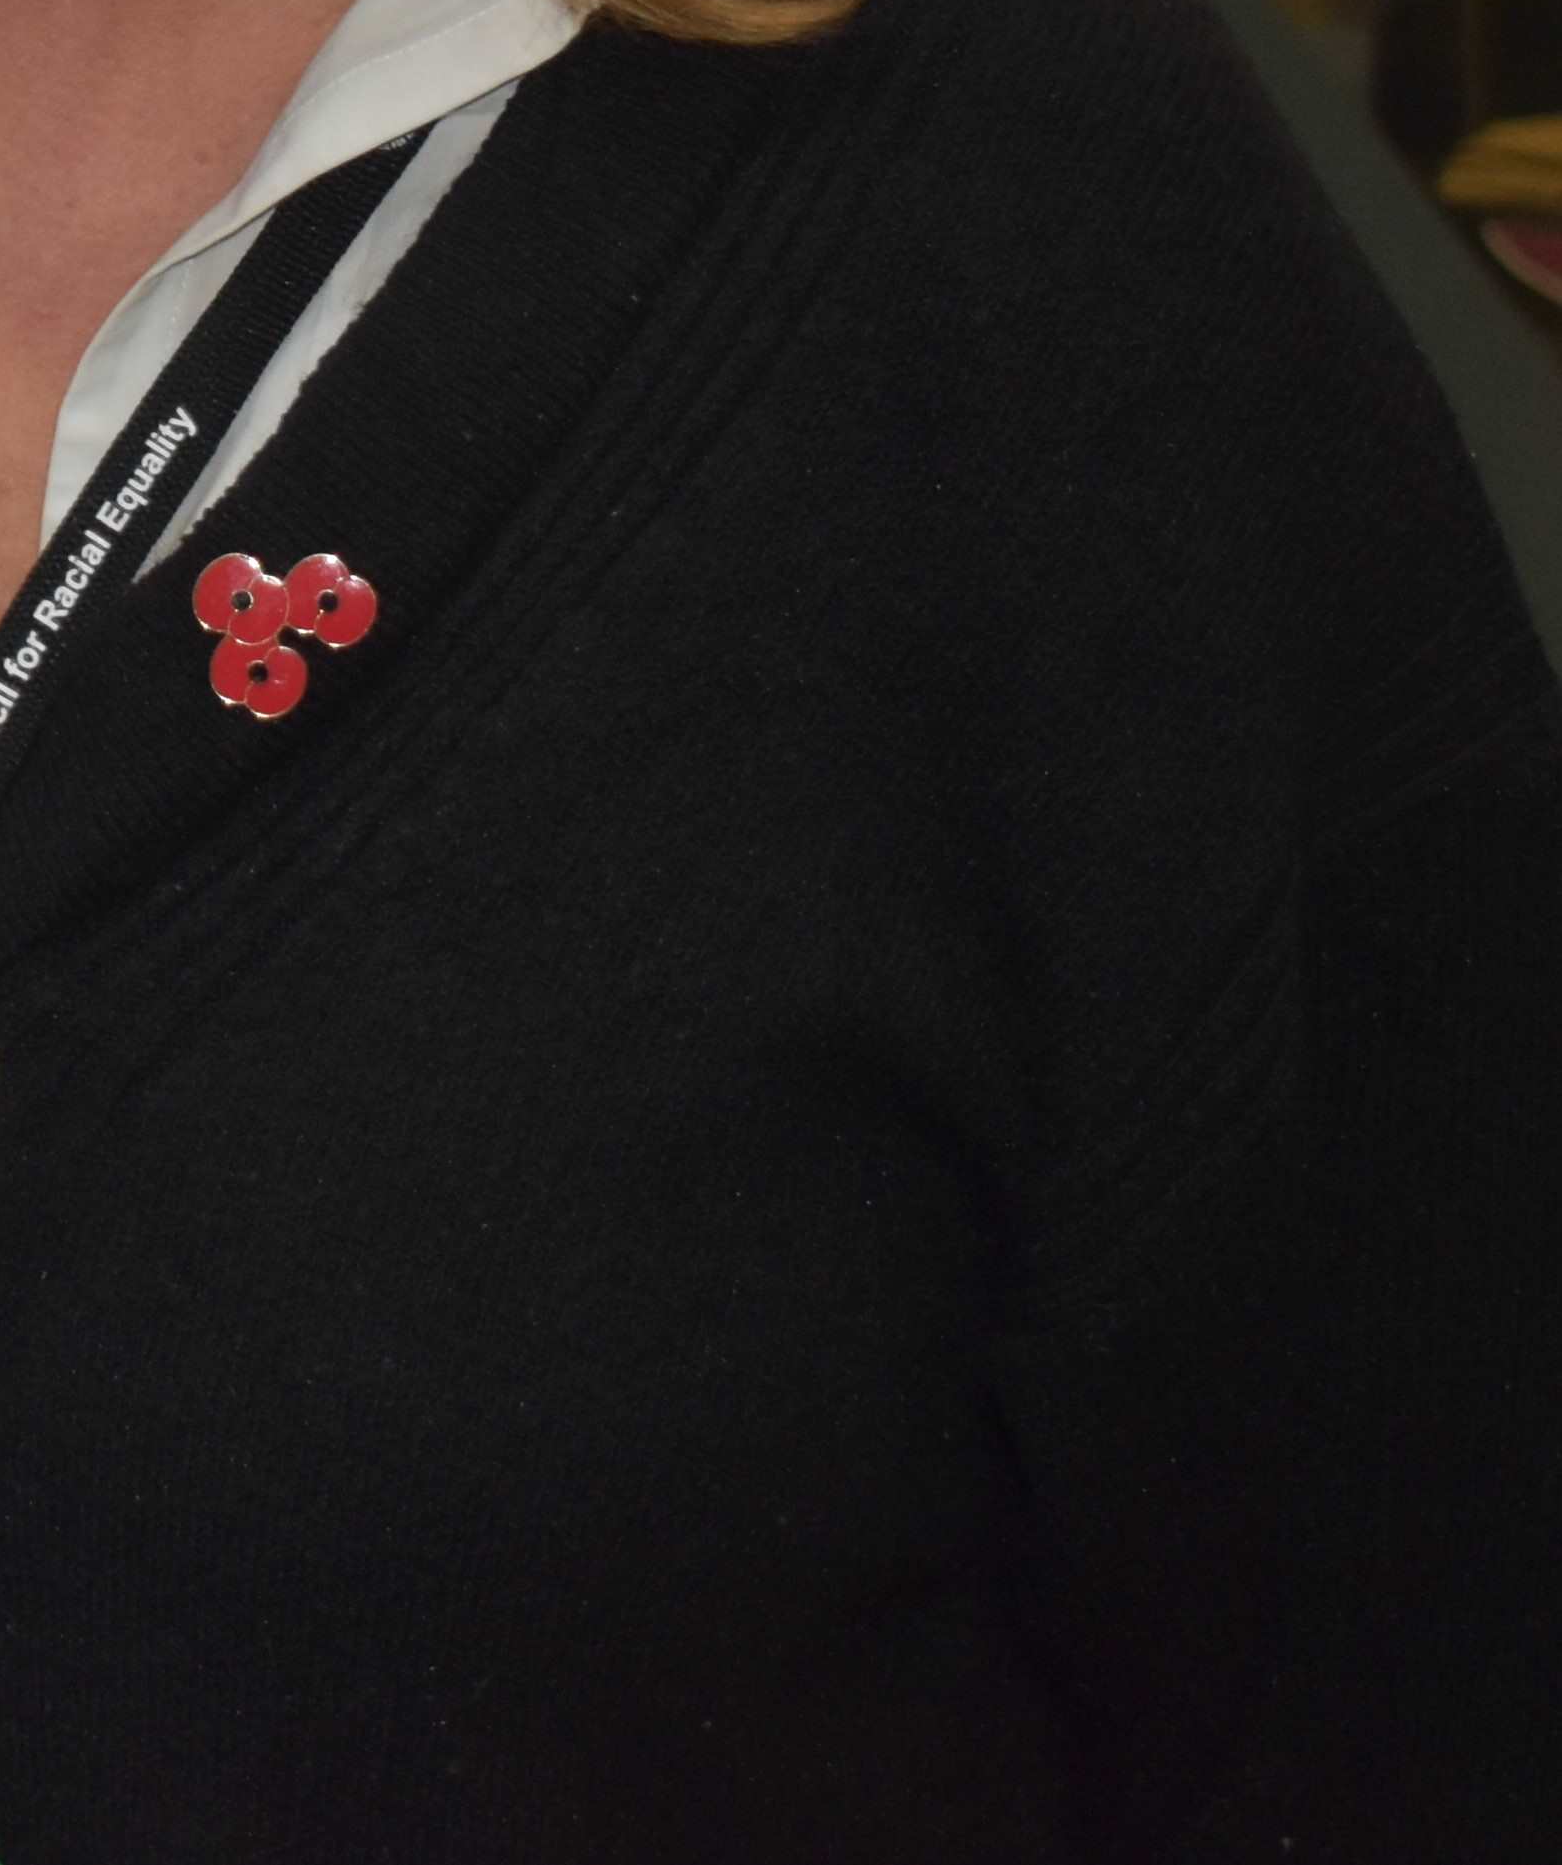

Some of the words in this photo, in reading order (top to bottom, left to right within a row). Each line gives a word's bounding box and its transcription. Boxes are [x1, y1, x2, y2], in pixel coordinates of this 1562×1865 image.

[4, 631, 47, 681] for
[33, 530, 111, 631] Racial
[96, 406, 197, 532] Equality
